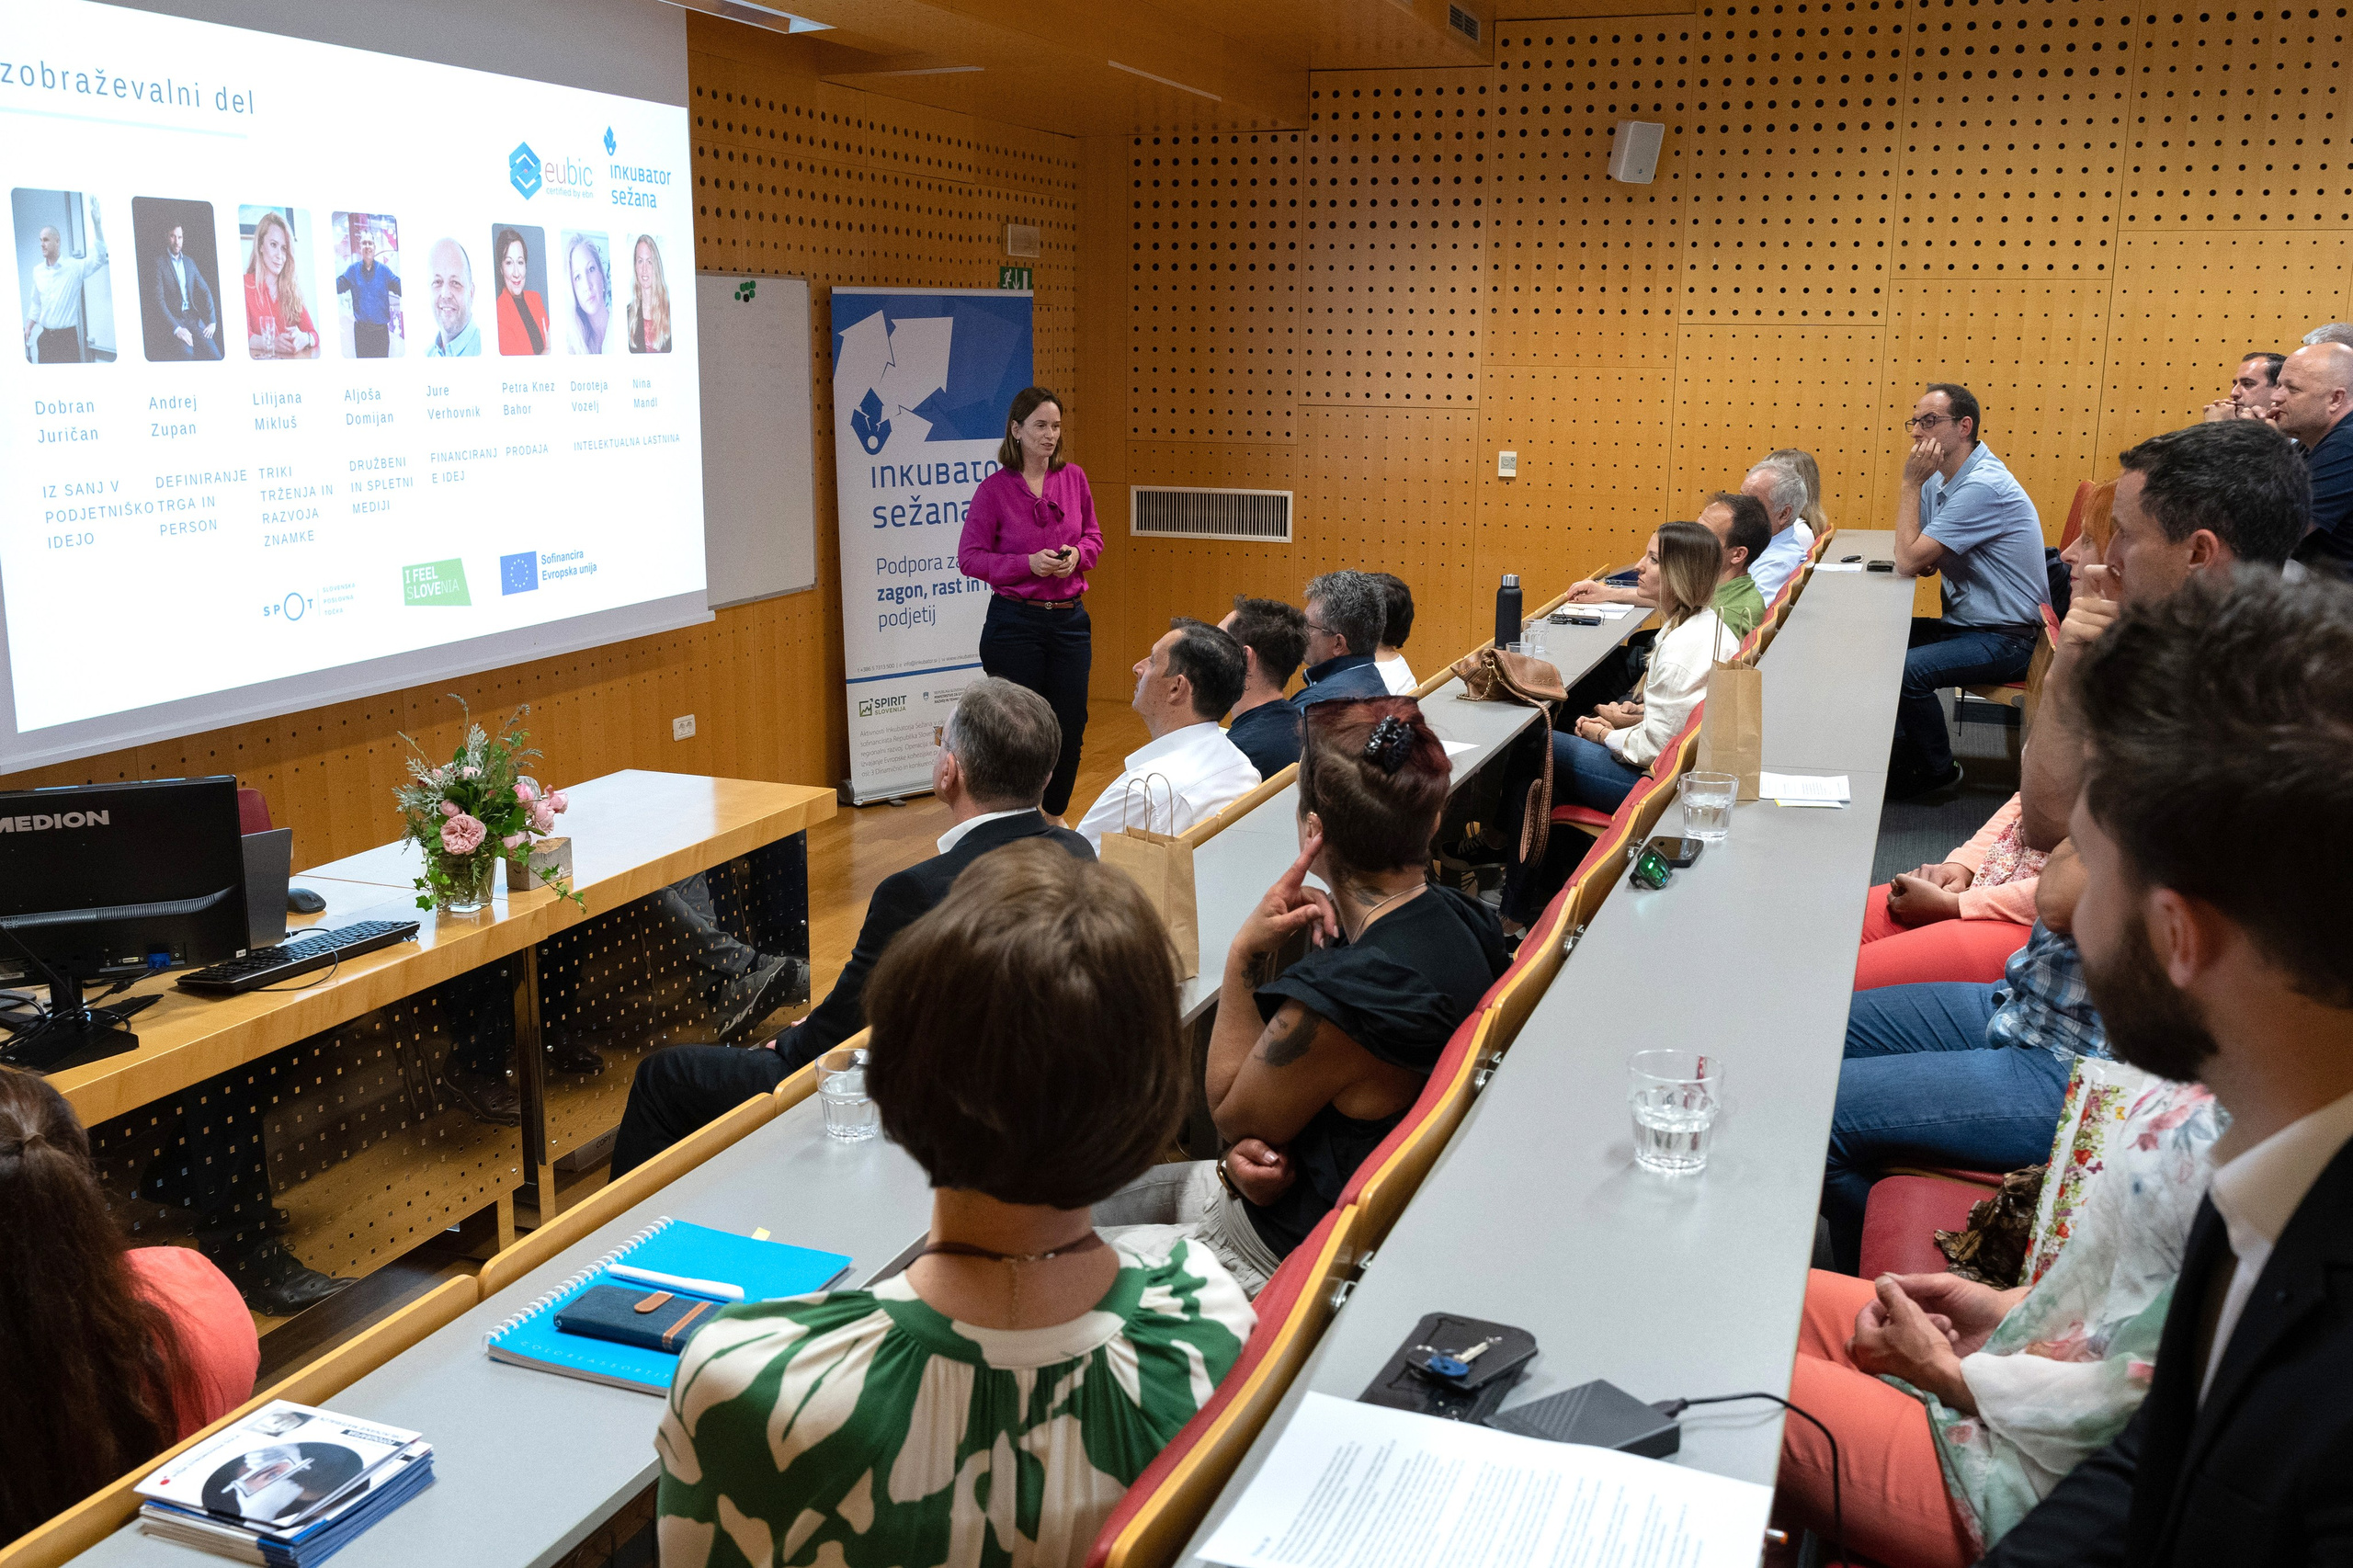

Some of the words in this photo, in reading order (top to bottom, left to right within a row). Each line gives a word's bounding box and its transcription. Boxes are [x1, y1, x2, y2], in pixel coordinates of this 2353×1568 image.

[0, 61, 200, 108] zobraževalni
[215, 86, 255, 114] del
[544, 156, 593, 187] eubic
[546, 187, 572, 198] certified
[572, 189, 581, 199] by
[582, 189, 594, 199] ebn
[611, 187, 657, 209] sežana
[426, 384, 449, 397] Jure
[502, 381, 529, 393] Petra
[532, 381, 556, 392] Knez
[570, 380, 608, 394] Doroteja
[632, 378, 652, 389] Nina
[149, 394, 198, 412] Andrej
[253, 391, 302, 408] Lilijana
[344, 387, 381, 404] Aljoša
[633, 397, 658, 409] Mandl
[35, 400, 95, 415] Dobran
[427, 405, 481, 420] Verhovnik
[503, 403, 532, 416] Bahor
[571, 400, 599, 414] Vozelj
[255, 415, 297, 430] Mikluš
[346, 411, 394, 426] Domijan
[38, 426, 98, 443] Juričan
[151, 423, 197, 438] Zupan
[506, 443, 549, 457] PRODAJA
[574, 436, 641, 451] INTELEKTUALNA
[642, 433, 680, 446] LASTNINA
[430, 448, 497, 463] FINANCIRANJ
[258, 466, 292, 480] TRIKI
[349, 457, 406, 472] DRUŽBENI
[155, 469, 247, 489] DEFINIRANJE
[351, 482, 362, 493] IN
[367, 476, 414, 492] SPLETNI
[432, 472, 438, 483] E
[442, 470, 466, 483] IDEJ
[43, 485, 57, 499] IZ
[64, 481, 104, 496] SANJ
[110, 480, 119, 493] V
[260, 485, 316, 502] TRŽENJA
[322, 484, 334, 496] IN
[157, 497, 196, 512] TRGA
[202, 495, 216, 508] IN
[352, 500, 391, 514] MEDIJI
[45, 501, 154, 524] PODJETNIŠKO
[262, 507, 320, 525] RAZVOJA
[160, 518, 218, 536] PERSON
[48, 532, 95, 550] IDEJO
[264, 529, 315, 547] ZNAMKE
[540, 550, 584, 565] Sofinancira
[876, 555, 943, 577] Podpora
[404, 569, 411, 585] I
[413, 565, 438, 582] FEEL
[541, 565, 577, 581] Evropska
[579, 562, 597, 574] unija
[406, 578, 460, 600] SLOVENIA
[877, 583, 927, 605] zagon,
[932, 577, 962, 596] rast
[967, 575, 979, 593] in
[879, 605, 936, 632] podjetij
[874, 695, 907, 709] SPIRIT
[874, 706, 906, 715] SLOVENIJA
